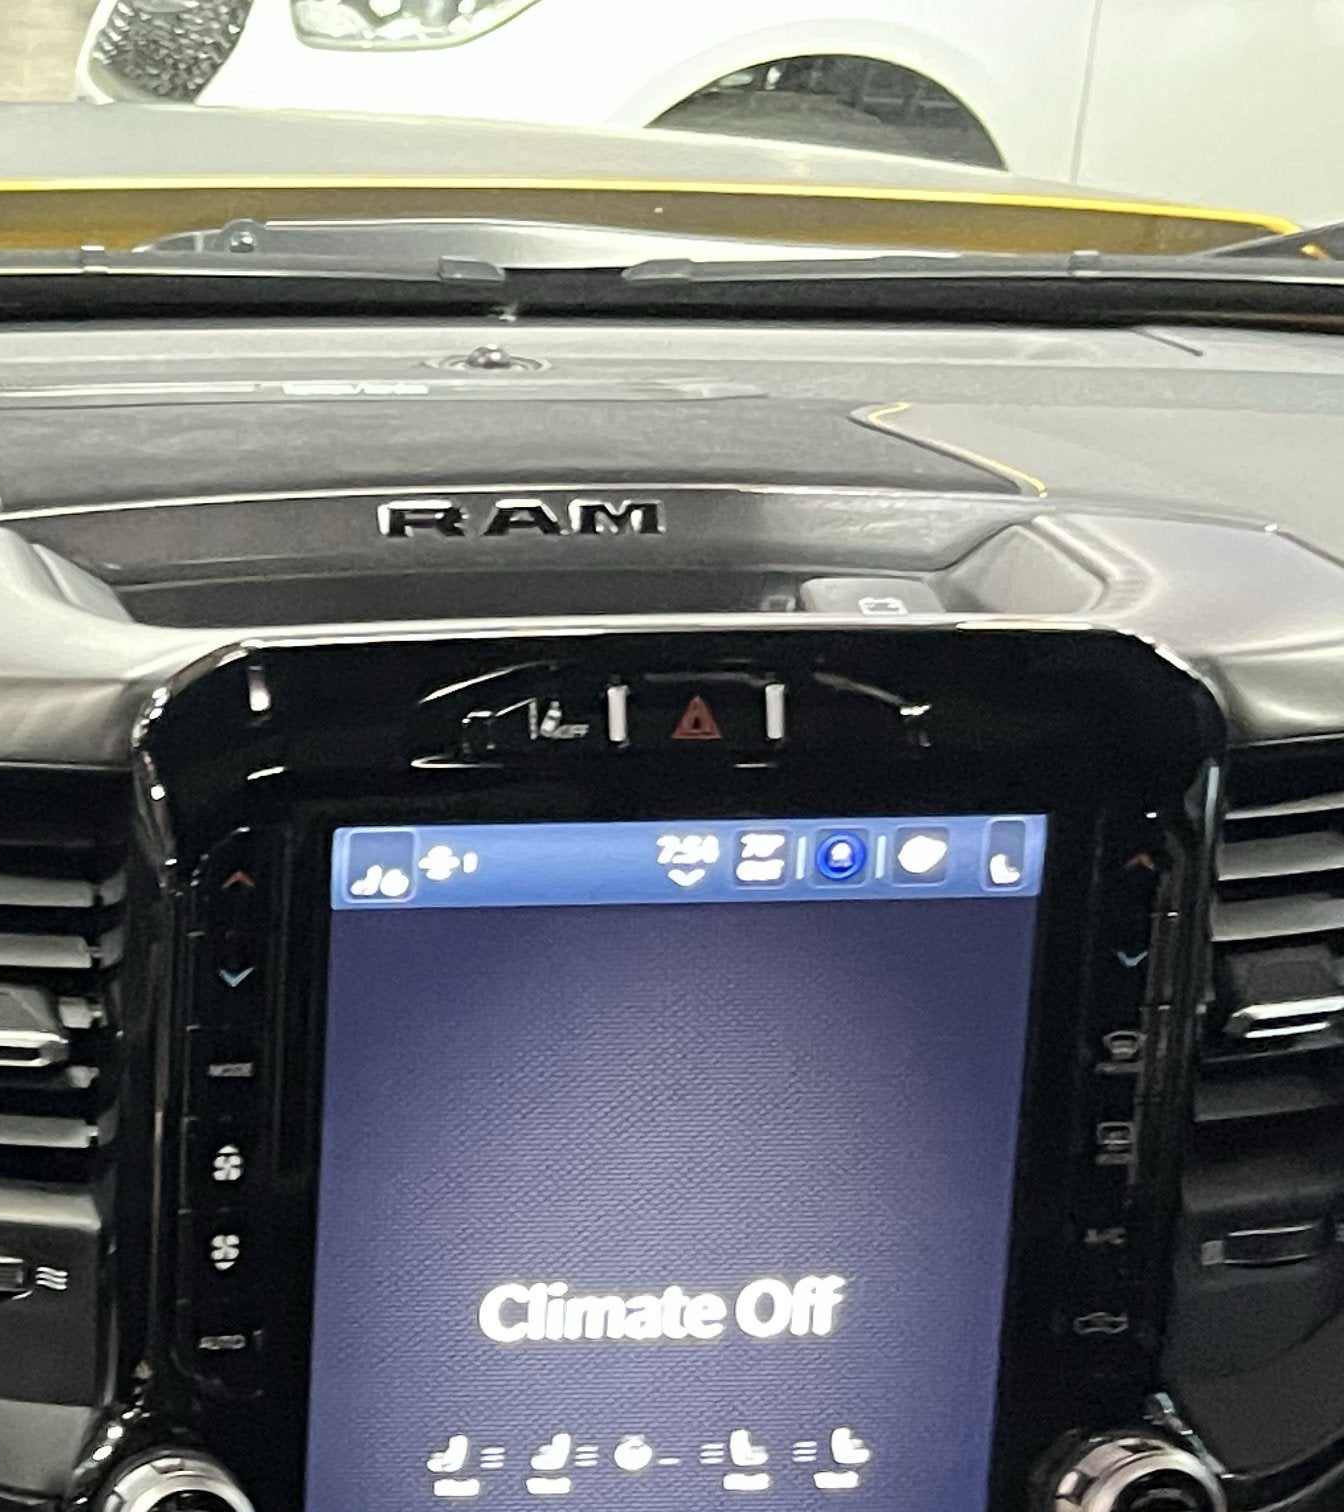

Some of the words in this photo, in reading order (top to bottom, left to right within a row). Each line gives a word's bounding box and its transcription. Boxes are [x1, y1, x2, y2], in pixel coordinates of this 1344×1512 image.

[377, 498, 666, 536] RAM
[478, 1282, 726, 1342] Climate
[735, 1275, 846, 1338] Off
